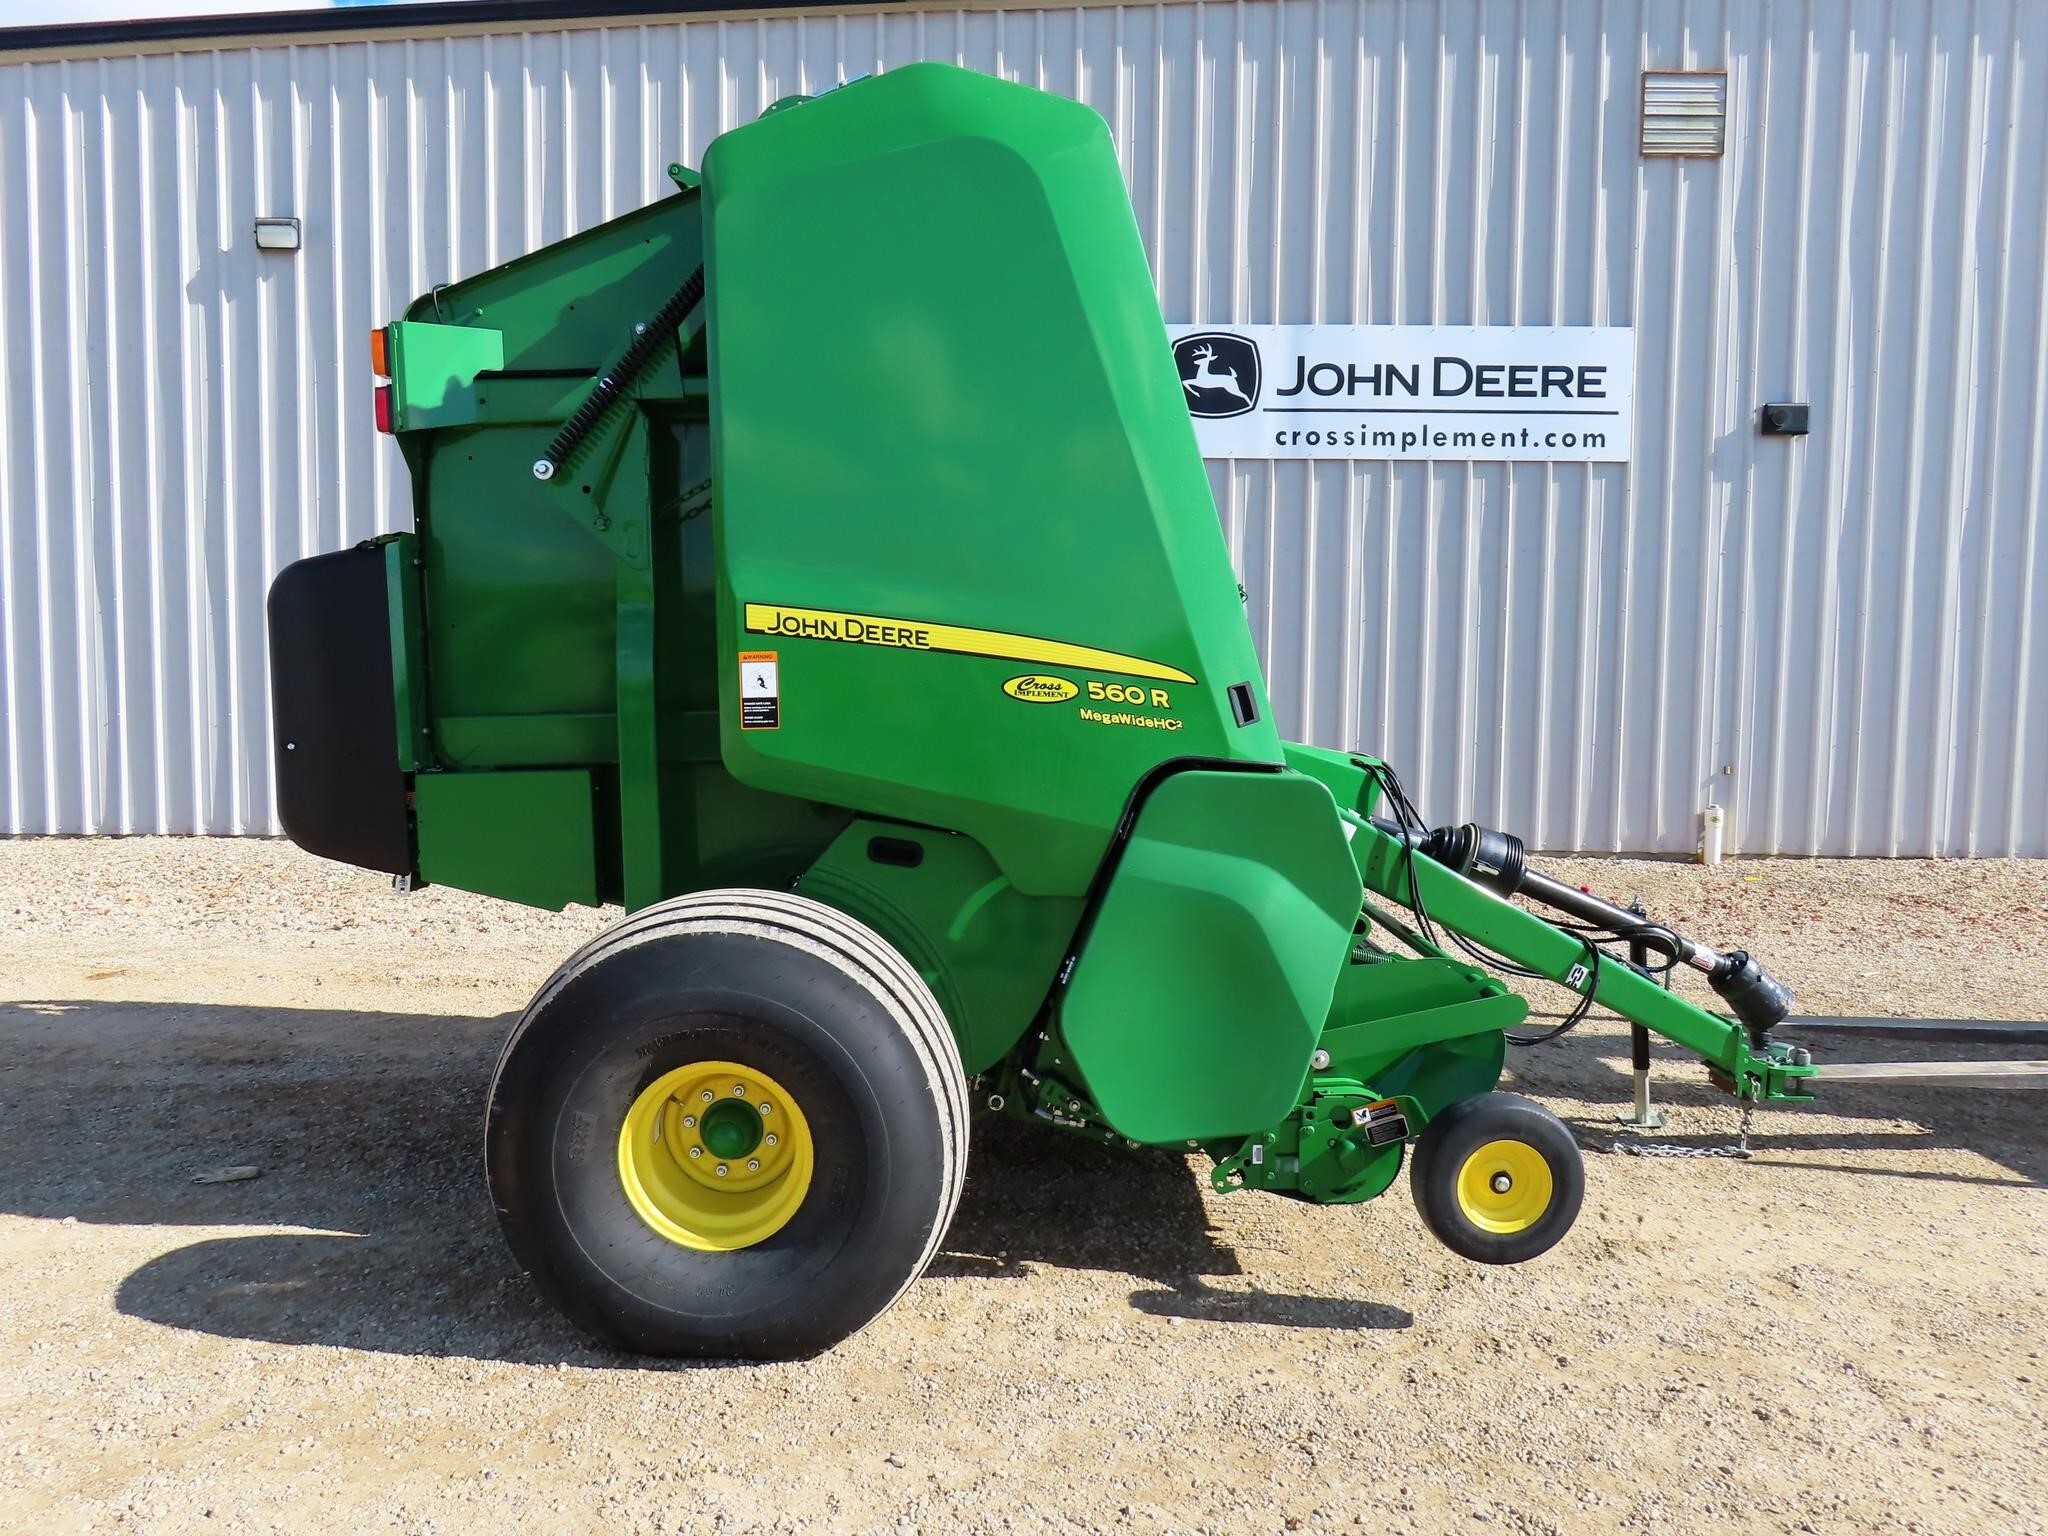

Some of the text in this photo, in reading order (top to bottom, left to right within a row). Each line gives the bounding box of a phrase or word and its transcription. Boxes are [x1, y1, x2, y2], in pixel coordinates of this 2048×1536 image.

[1276, 355, 1607, 399] JOHN DEERE
[1275, 424, 1607, 452] crossimplement.com
[767, 611, 930, 647] JOHN DEERE
[1013, 689, 1070, 699] IMPLEMENT
[1016, 677, 1064, 692] Cross
[1087, 681, 1171, 709] 560 R
